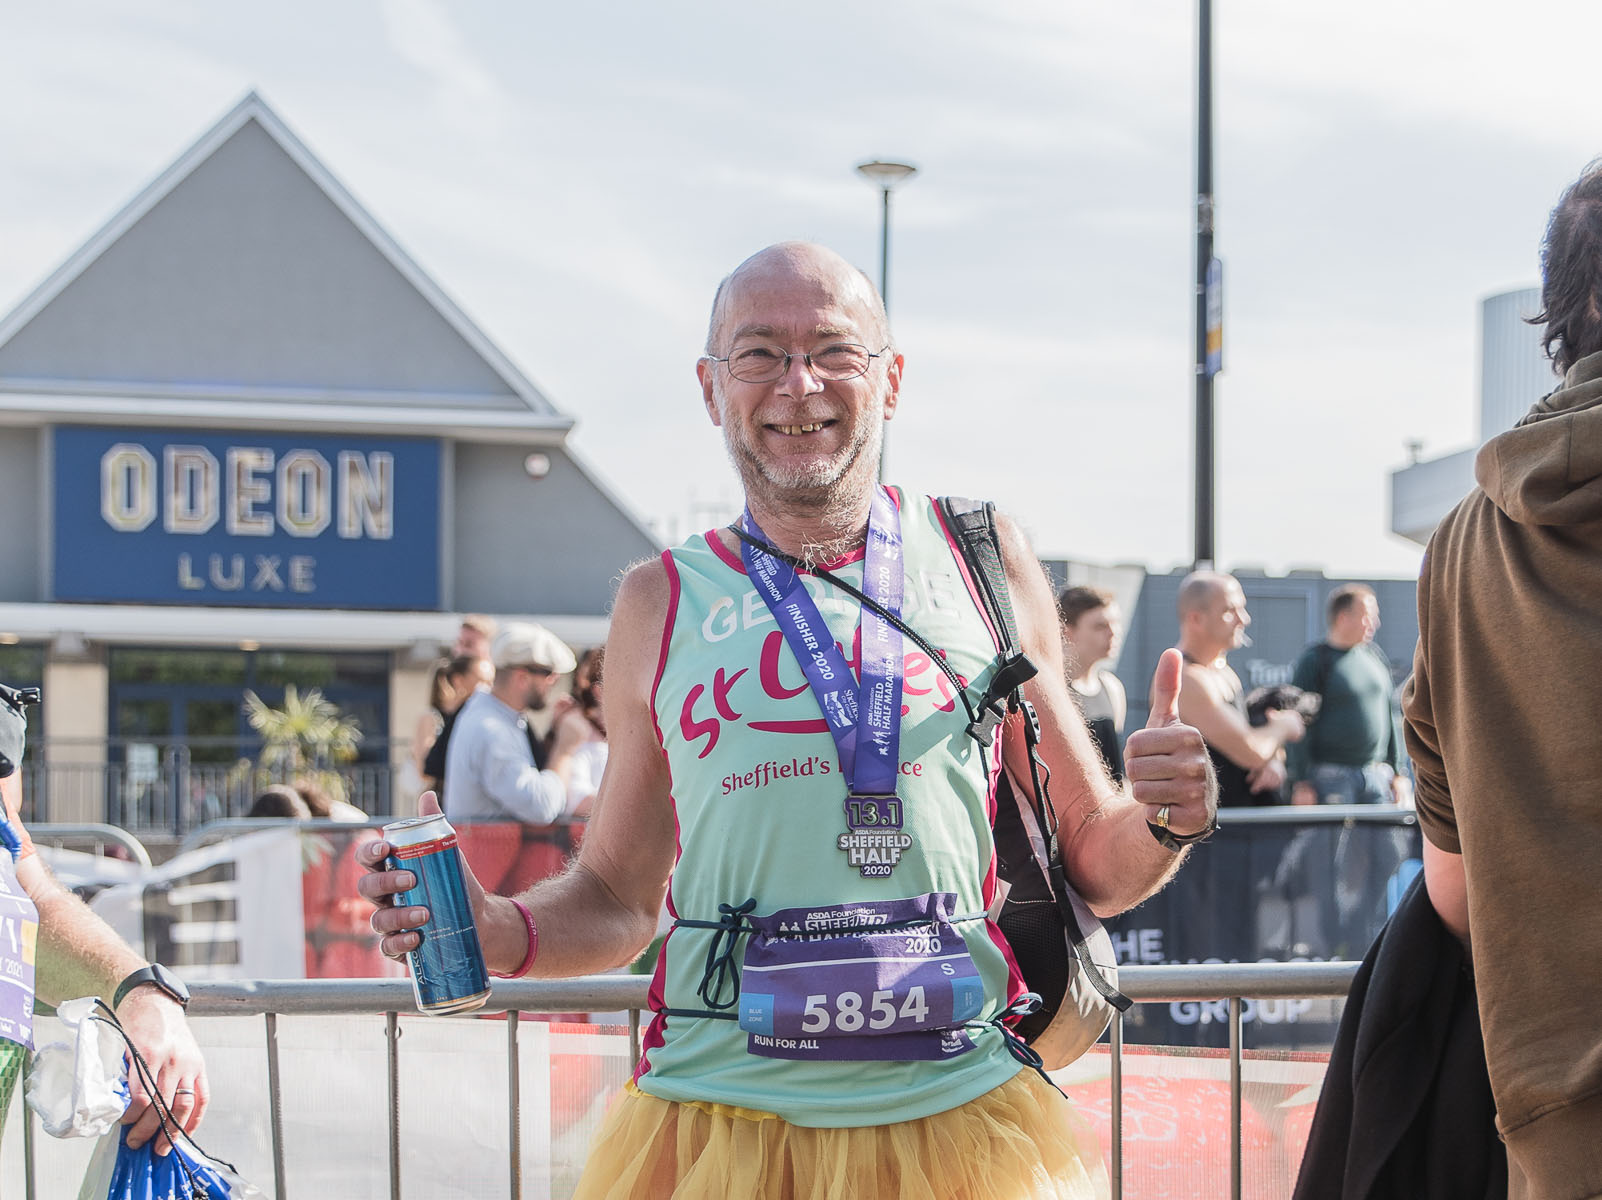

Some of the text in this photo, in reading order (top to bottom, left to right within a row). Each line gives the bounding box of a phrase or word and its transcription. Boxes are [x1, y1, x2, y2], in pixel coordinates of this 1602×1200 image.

[101, 442, 394, 540] ODEON
[177, 552, 317, 592] LUXE
[879, 566, 890, 594] 2020
[786, 603, 835, 681] FINISHER 2020
[872, 682, 884, 728] SHEFFIELD
[882, 652, 895, 730] HALF MARATHON
[722, 757, 830, 795] Sheffield's
[849, 801, 899, 825] 13.1
[840, 835, 912, 848] SHEFFIELD
[851, 848, 900, 864] HALF
[864, 865, 891, 875] 2020
[806, 907, 875, 920] ASDA Foundation
[905, 937, 942, 953] 2020
[1111, 928, 1164, 963] HE
[940, 963, 955, 976] S
[801, 985, 929, 1033] 5854
[754, 1035, 819, 1049] RUN FOR ALL
